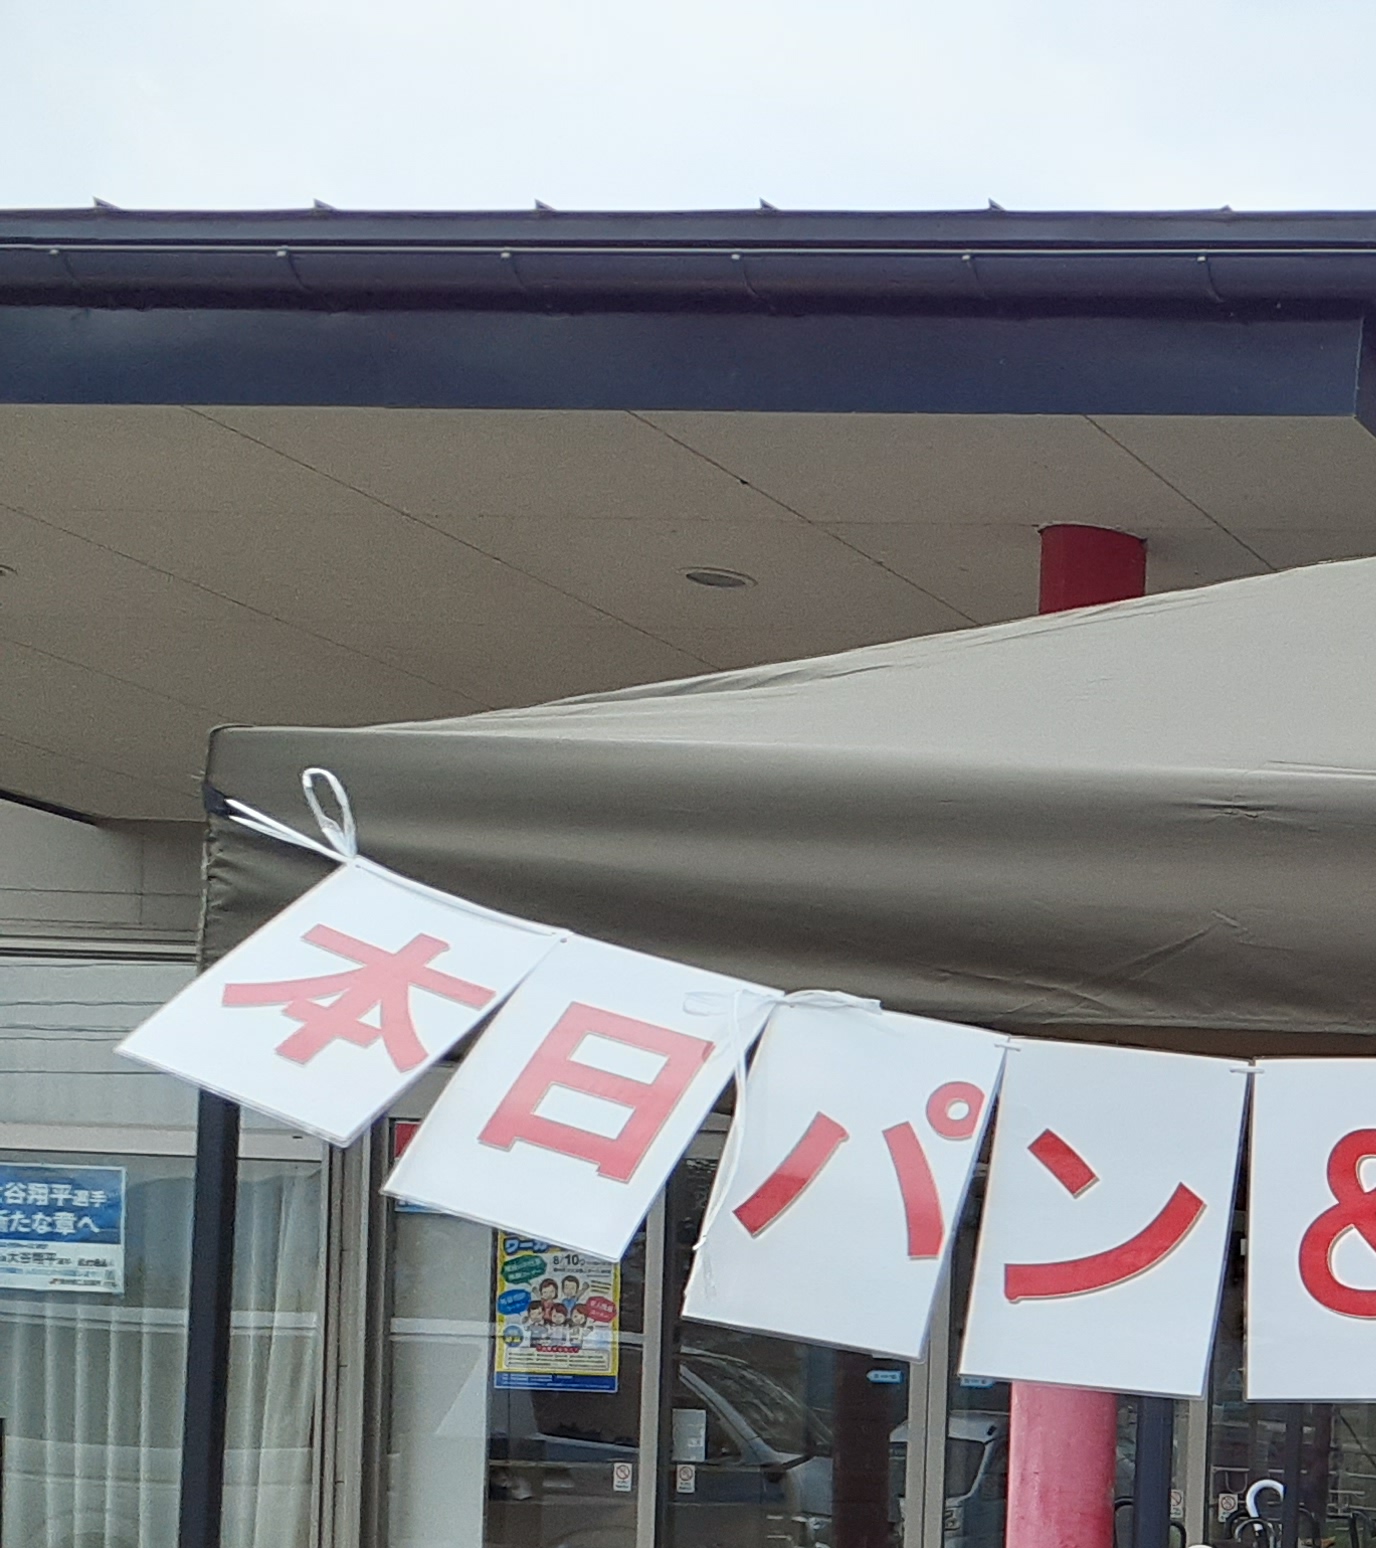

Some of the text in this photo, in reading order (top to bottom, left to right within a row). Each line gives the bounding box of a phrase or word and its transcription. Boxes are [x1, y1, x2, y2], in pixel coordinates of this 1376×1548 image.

[0, 1183, 107, 1207] 谷翔平選手
